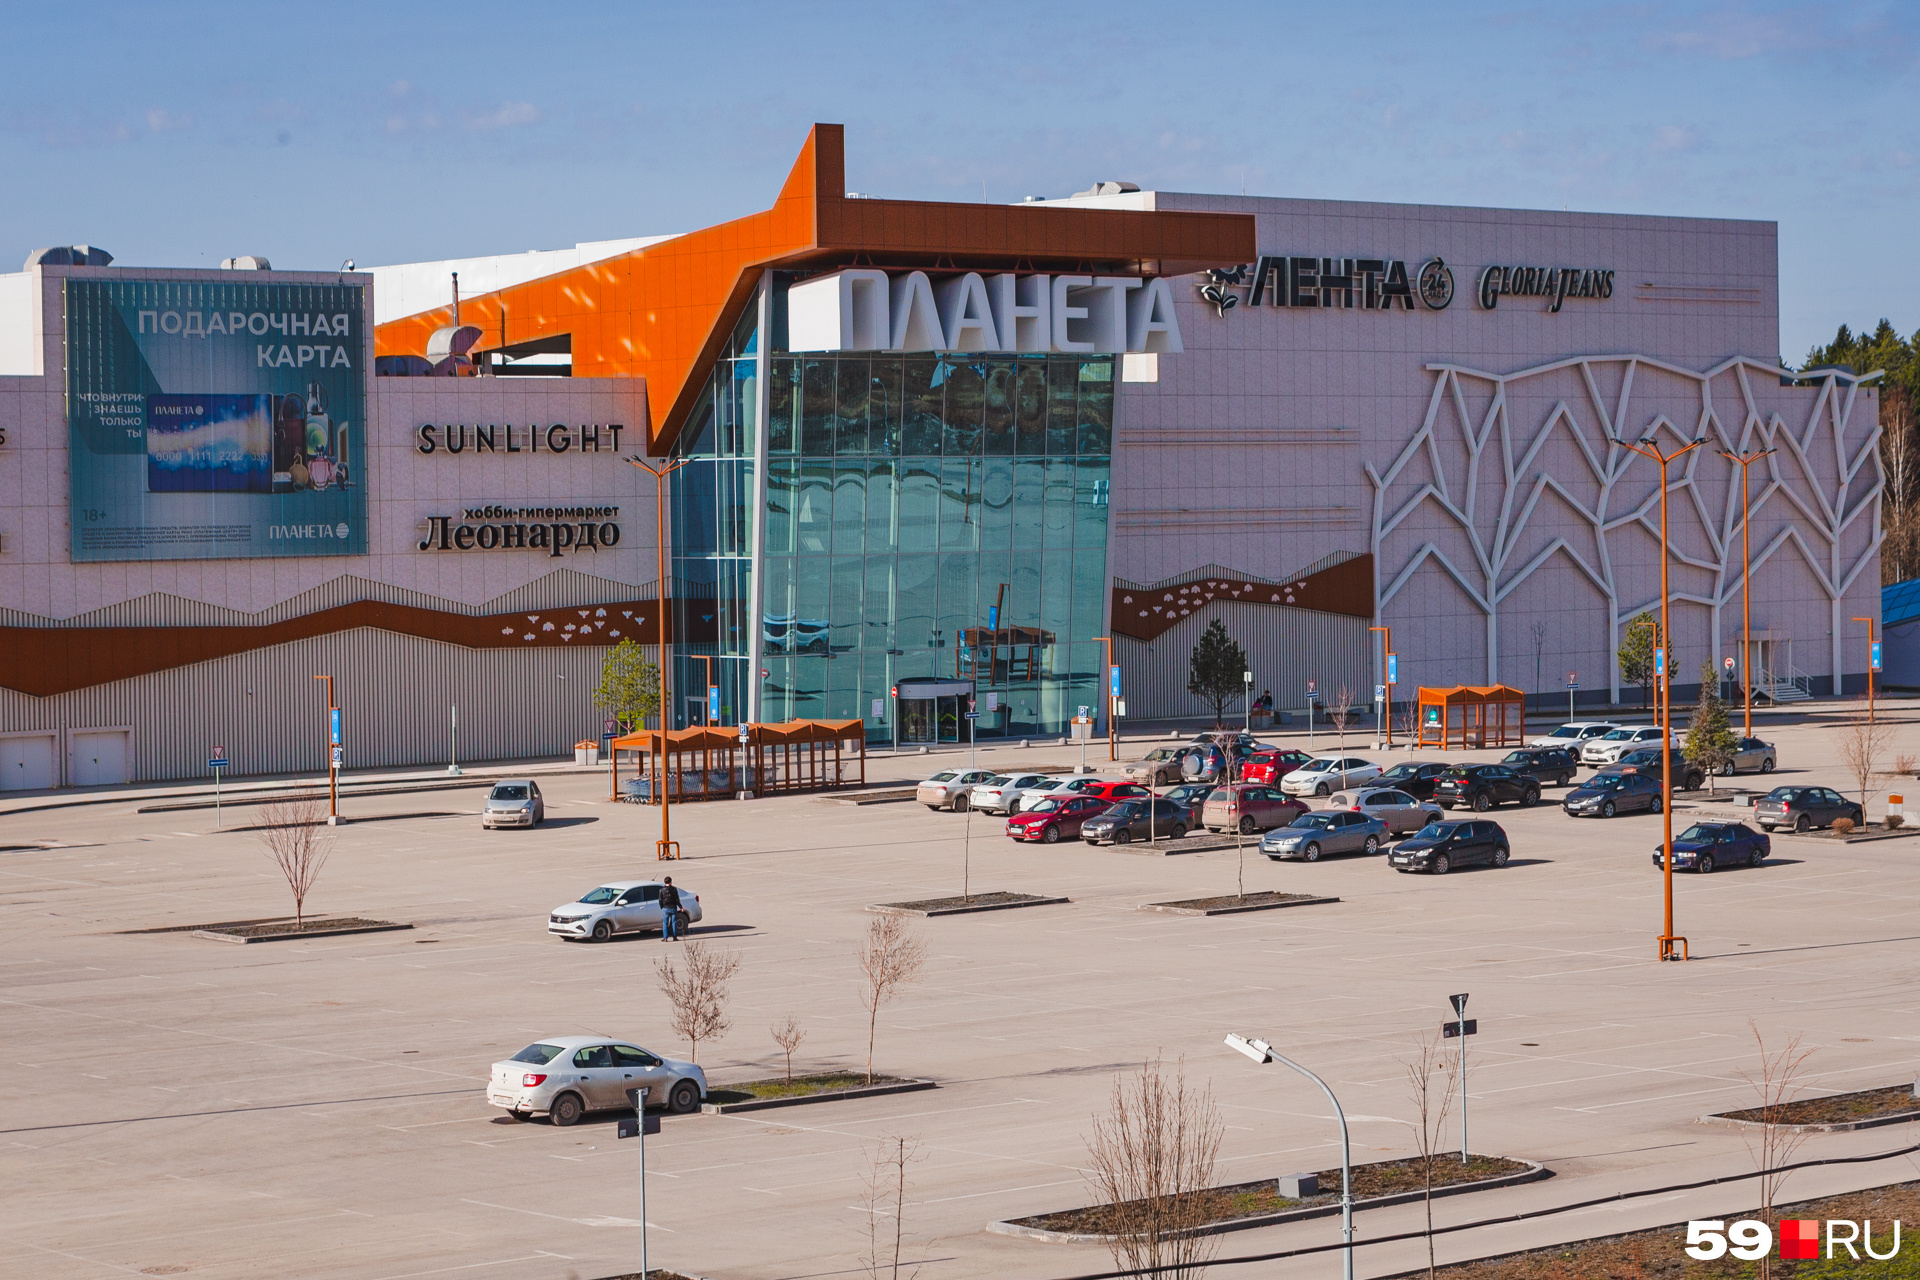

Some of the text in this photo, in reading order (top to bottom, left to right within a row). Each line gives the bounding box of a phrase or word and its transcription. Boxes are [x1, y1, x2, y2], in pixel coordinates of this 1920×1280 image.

[1248, 256, 1415, 310] ЛЕНТА
[1427, 273, 1446, 291] 24
[1479, 265, 1615, 313] GLORIA JEANS
[836, 268, 1185, 354] ПЛАНЕТА
[138, 310, 350, 339] ПОДАРОЧНАЯ
[257, 344, 351, 368] КАРТА
[79, 393, 100, 402] ЧТО
[94, 404, 142, 414] ЗНАЕШЬ
[155, 405, 195, 416] ПЛАНЕТА
[100, 417, 142, 426] ТОЛЬКО
[126, 429, 142, 438] ТЫ
[417, 423, 624, 455] SUNLIGHT
[189, 450, 212, 461] 1111
[219, 450, 243, 461] 2222
[83, 508, 107, 522] 18+
[463, 505, 620, 520] хобби-гипермаркет
[269, 524, 334, 540] ПЛАНЕТА
[417, 516, 621, 558] Леонардо
